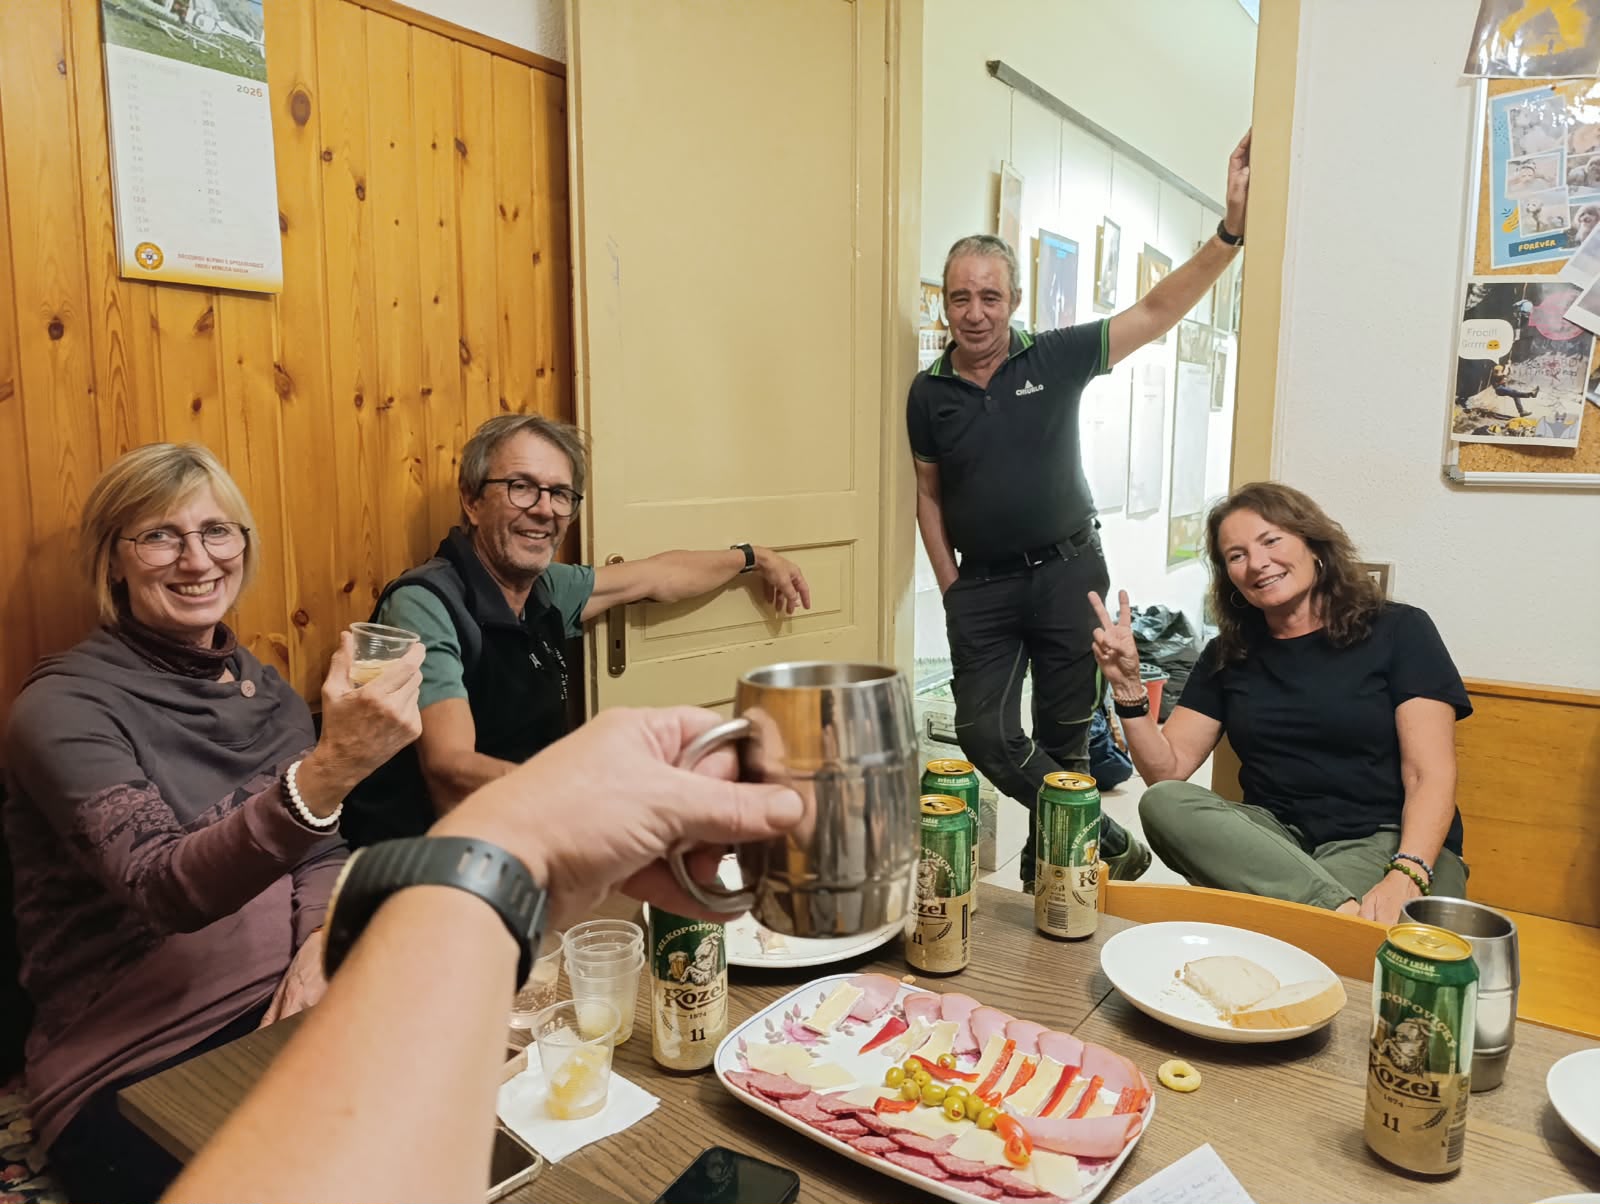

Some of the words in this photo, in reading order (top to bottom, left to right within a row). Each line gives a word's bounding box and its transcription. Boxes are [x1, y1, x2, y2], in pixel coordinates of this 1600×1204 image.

[235, 84, 263, 98] 2026
[1518, 240, 1556, 252] FOREVER
[664, 976, 725, 1011] Kozel
[689, 1027, 706, 1043] 11
[1382, 1112, 1401, 1134] 11
